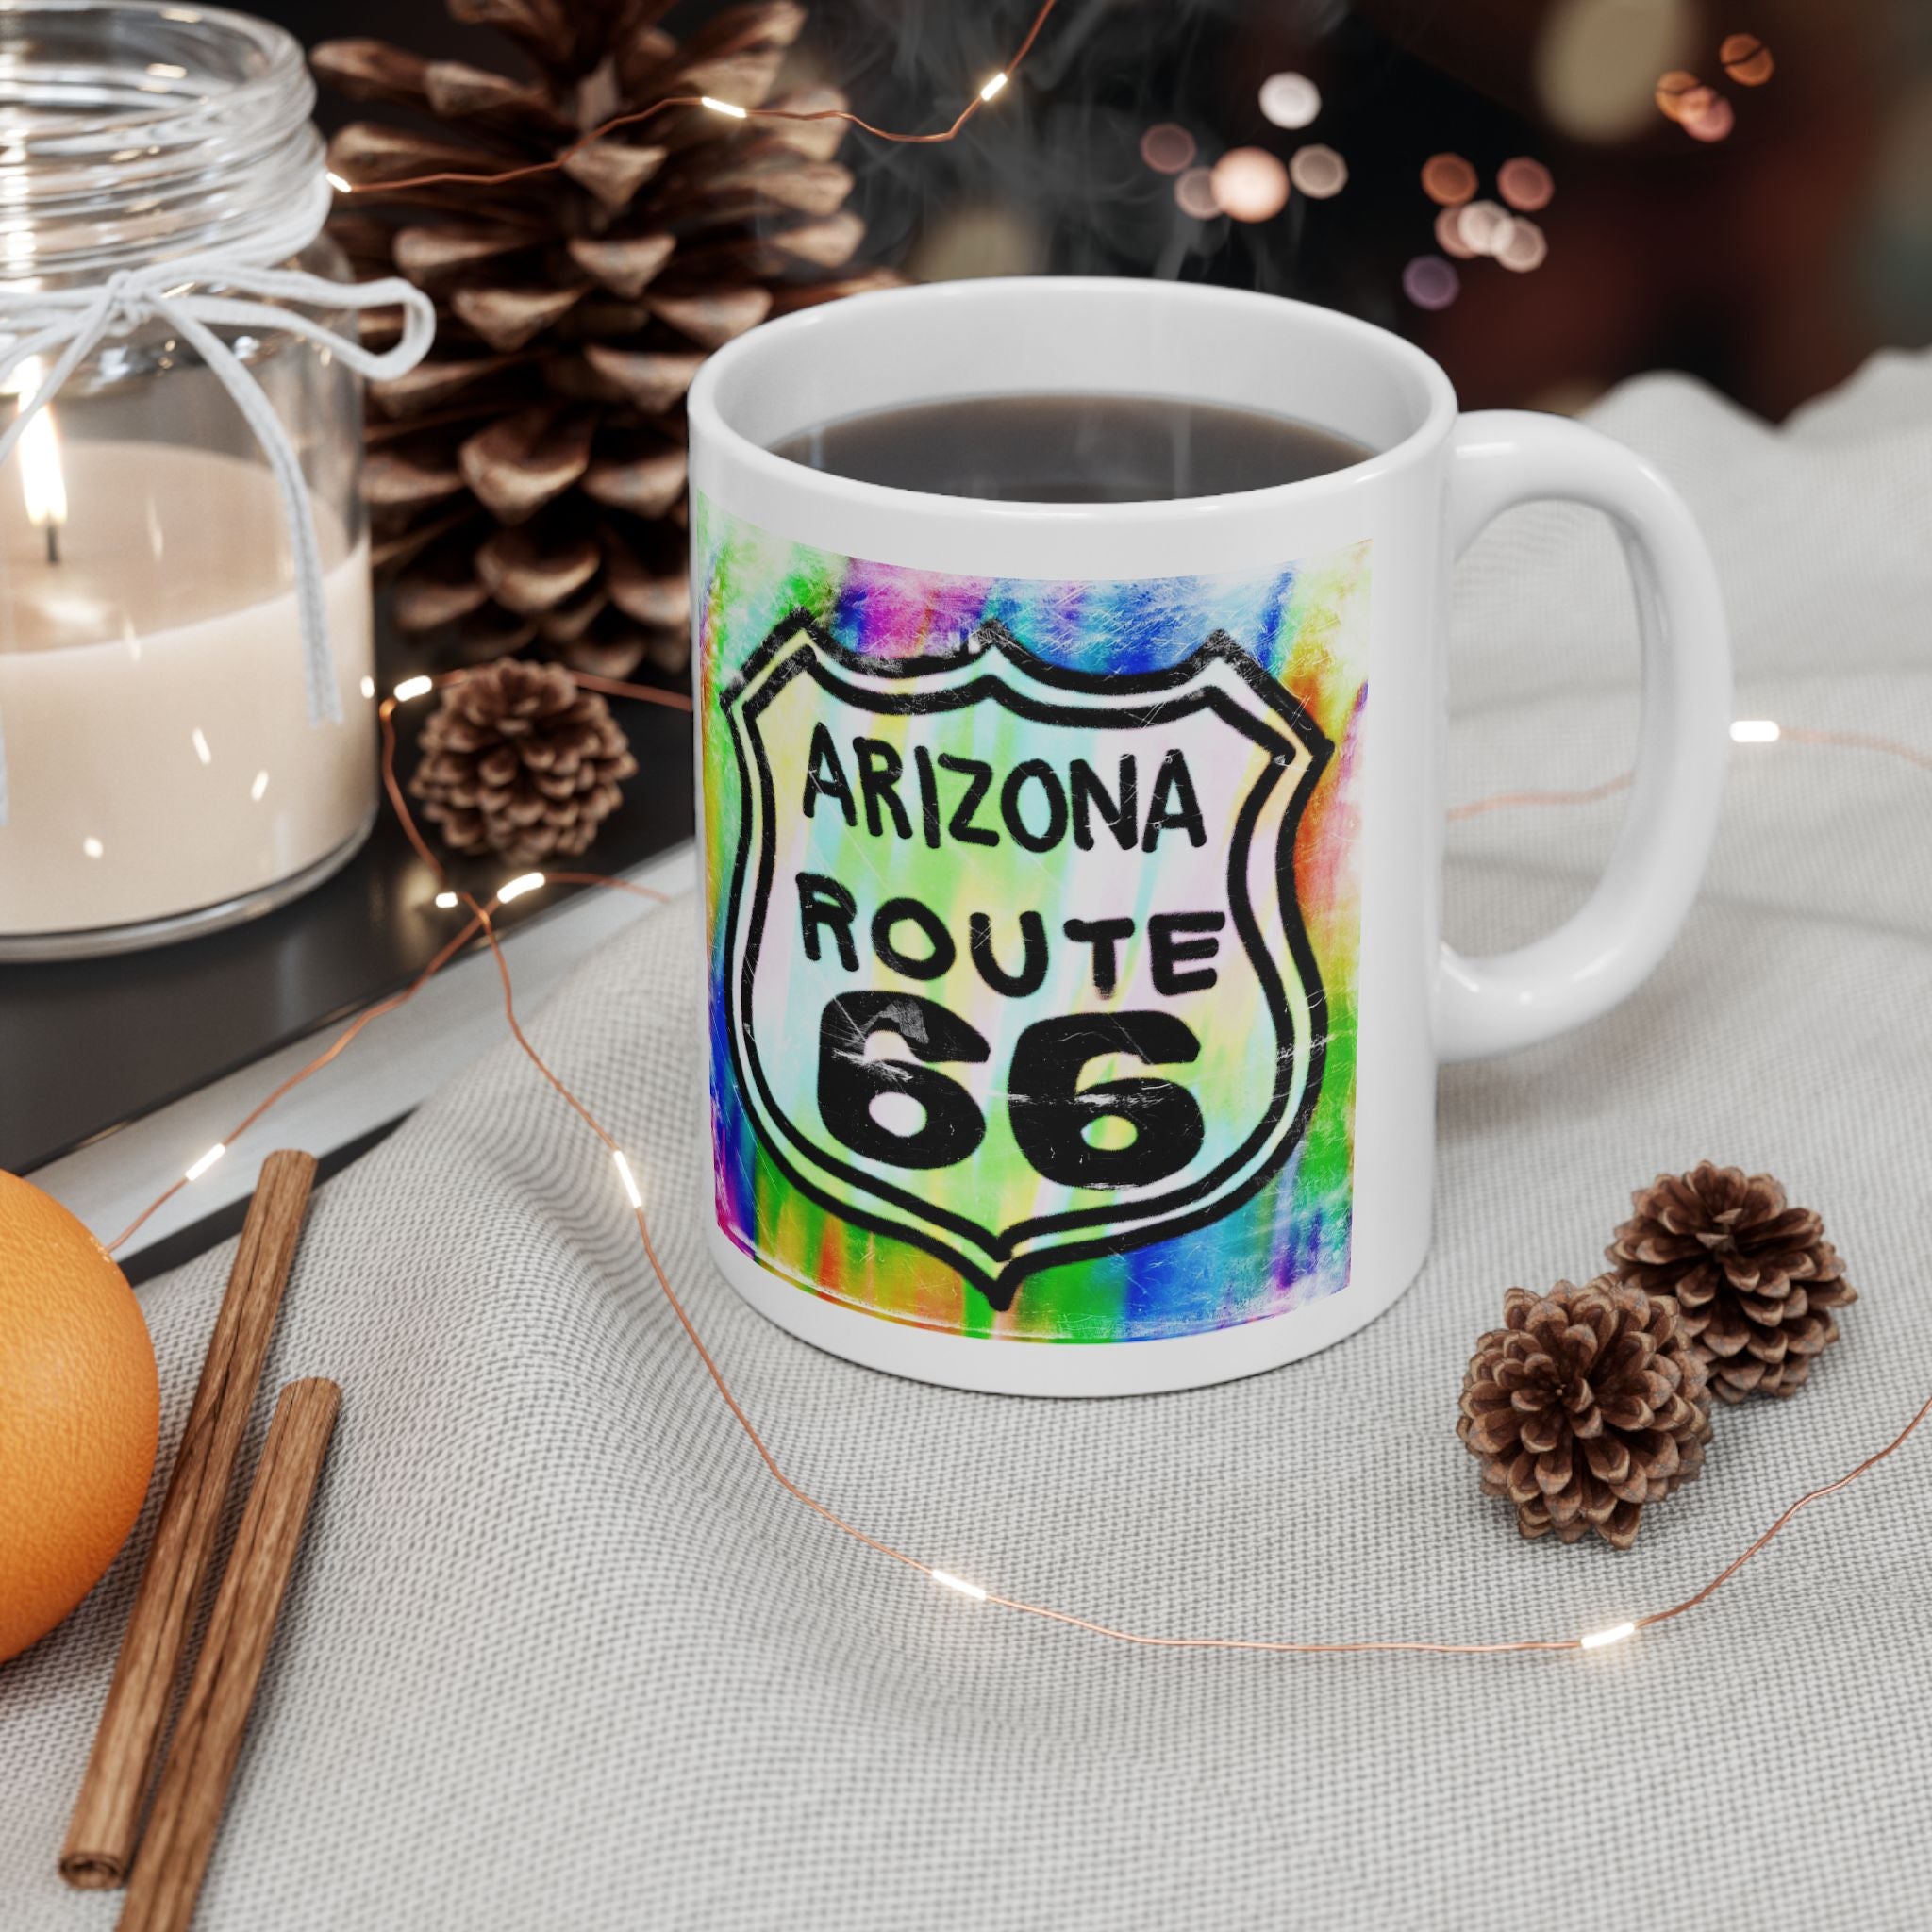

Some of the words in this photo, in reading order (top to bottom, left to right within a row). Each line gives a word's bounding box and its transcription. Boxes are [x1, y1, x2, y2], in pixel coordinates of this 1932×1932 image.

[803, 723, 1208, 854] ARIZONA
[794, 872, 1227, 999] ROUTE
[817, 991, 1206, 1191] 66
